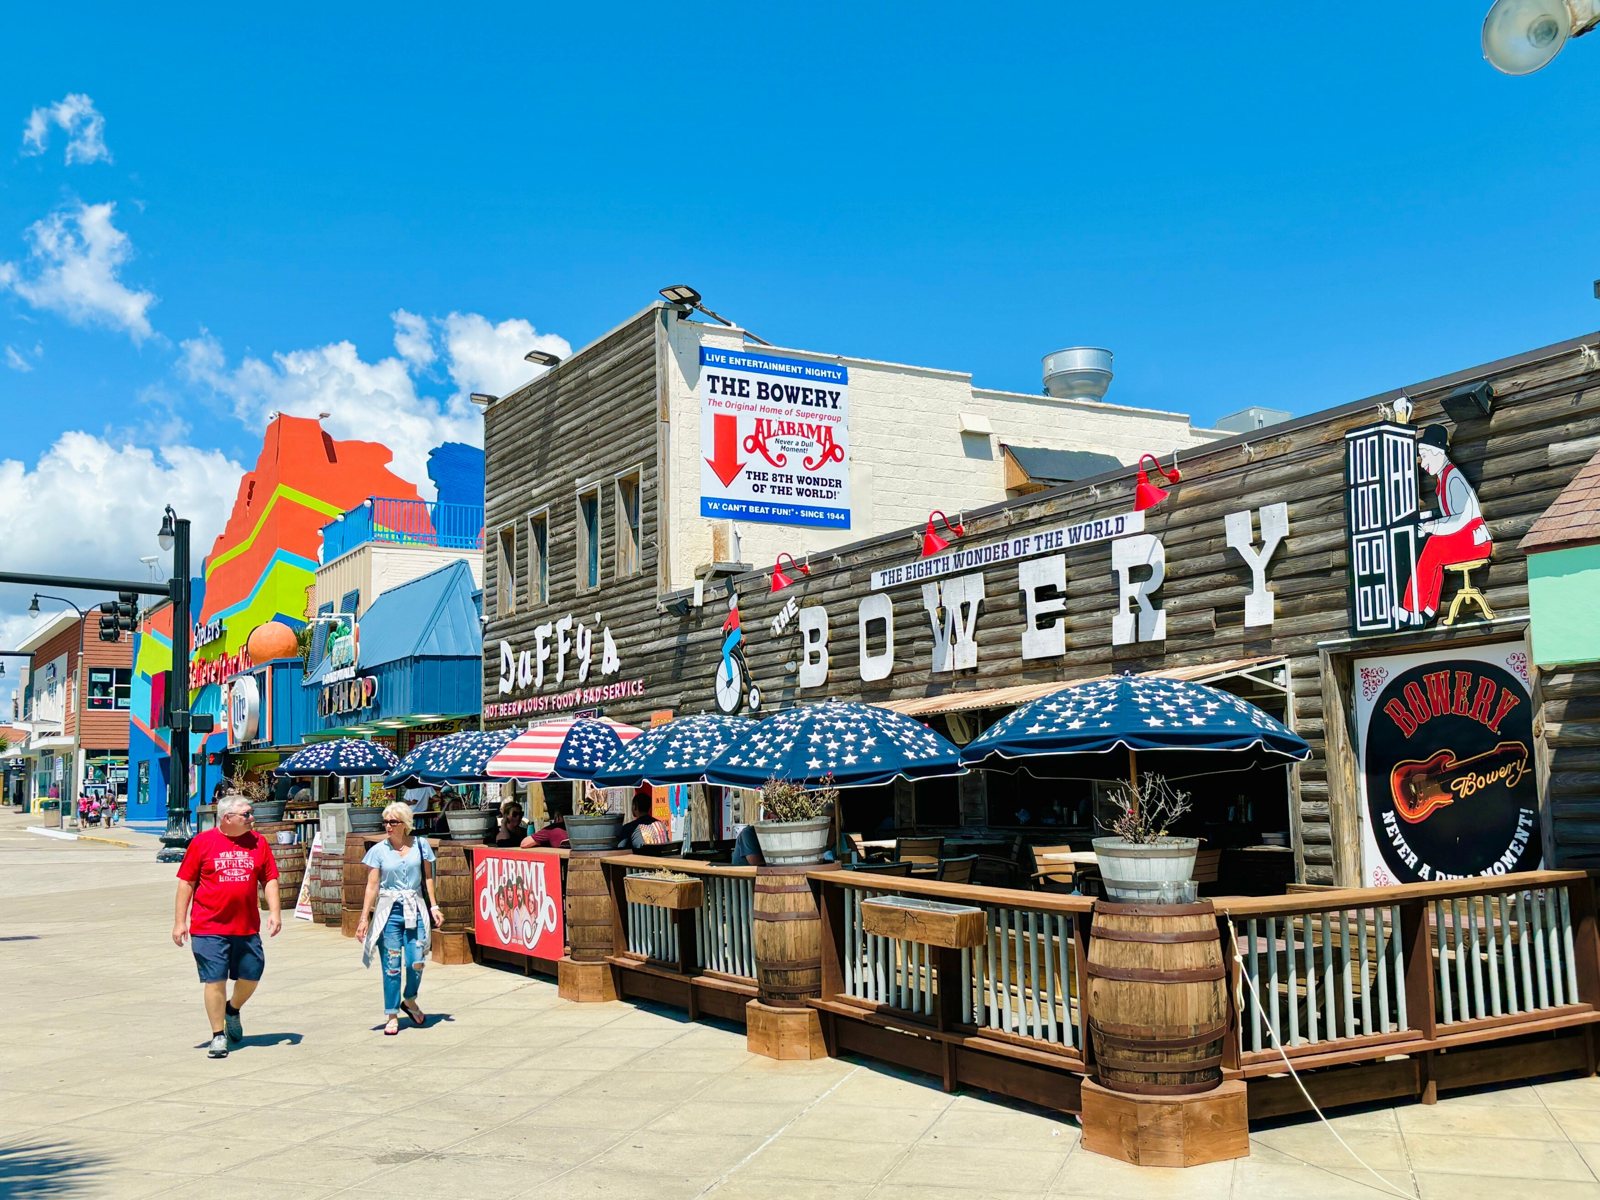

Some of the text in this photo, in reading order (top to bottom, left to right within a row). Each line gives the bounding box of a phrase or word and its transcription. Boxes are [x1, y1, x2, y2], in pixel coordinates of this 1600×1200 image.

[706, 353, 842, 380] LIVE ENTERTAINMENT NIGHTLY
[707, 375, 841, 410] THE BOWERY
[708, 398, 842, 423] The Original Home of Supergroup
[775, 438, 794, 447] Never
[801, 440, 814, 448] Dull
[780, 445, 808, 455] Moment!
[745, 471, 842, 488] THE 8TH WONDER
[752, 484, 837, 500] OF THE WORLD!
[707, 502, 845, 520] YA' CAN'T BEAT FUN! SINCE 1944
[880, 517, 1125, 587] THE EIGHTH WONDER OF THE WORLD
[772, 502, 1288, 688] THE BOWERY
[332, 677, 375, 713] SHOP
[484, 679, 645, 719] HOT BEER LOUSY FOOD BAD SERVICE
[1383, 669, 1521, 739] BOWERY
[233, 694, 246, 730] Lite
[1450, 757, 1532, 798] Bowery
[219, 850, 249, 858] WALPOLE
[1382, 810, 1431, 880] NEVER A
[214, 858, 255, 871] EXPRESS
[219, 874, 251, 882] HOCKEY
